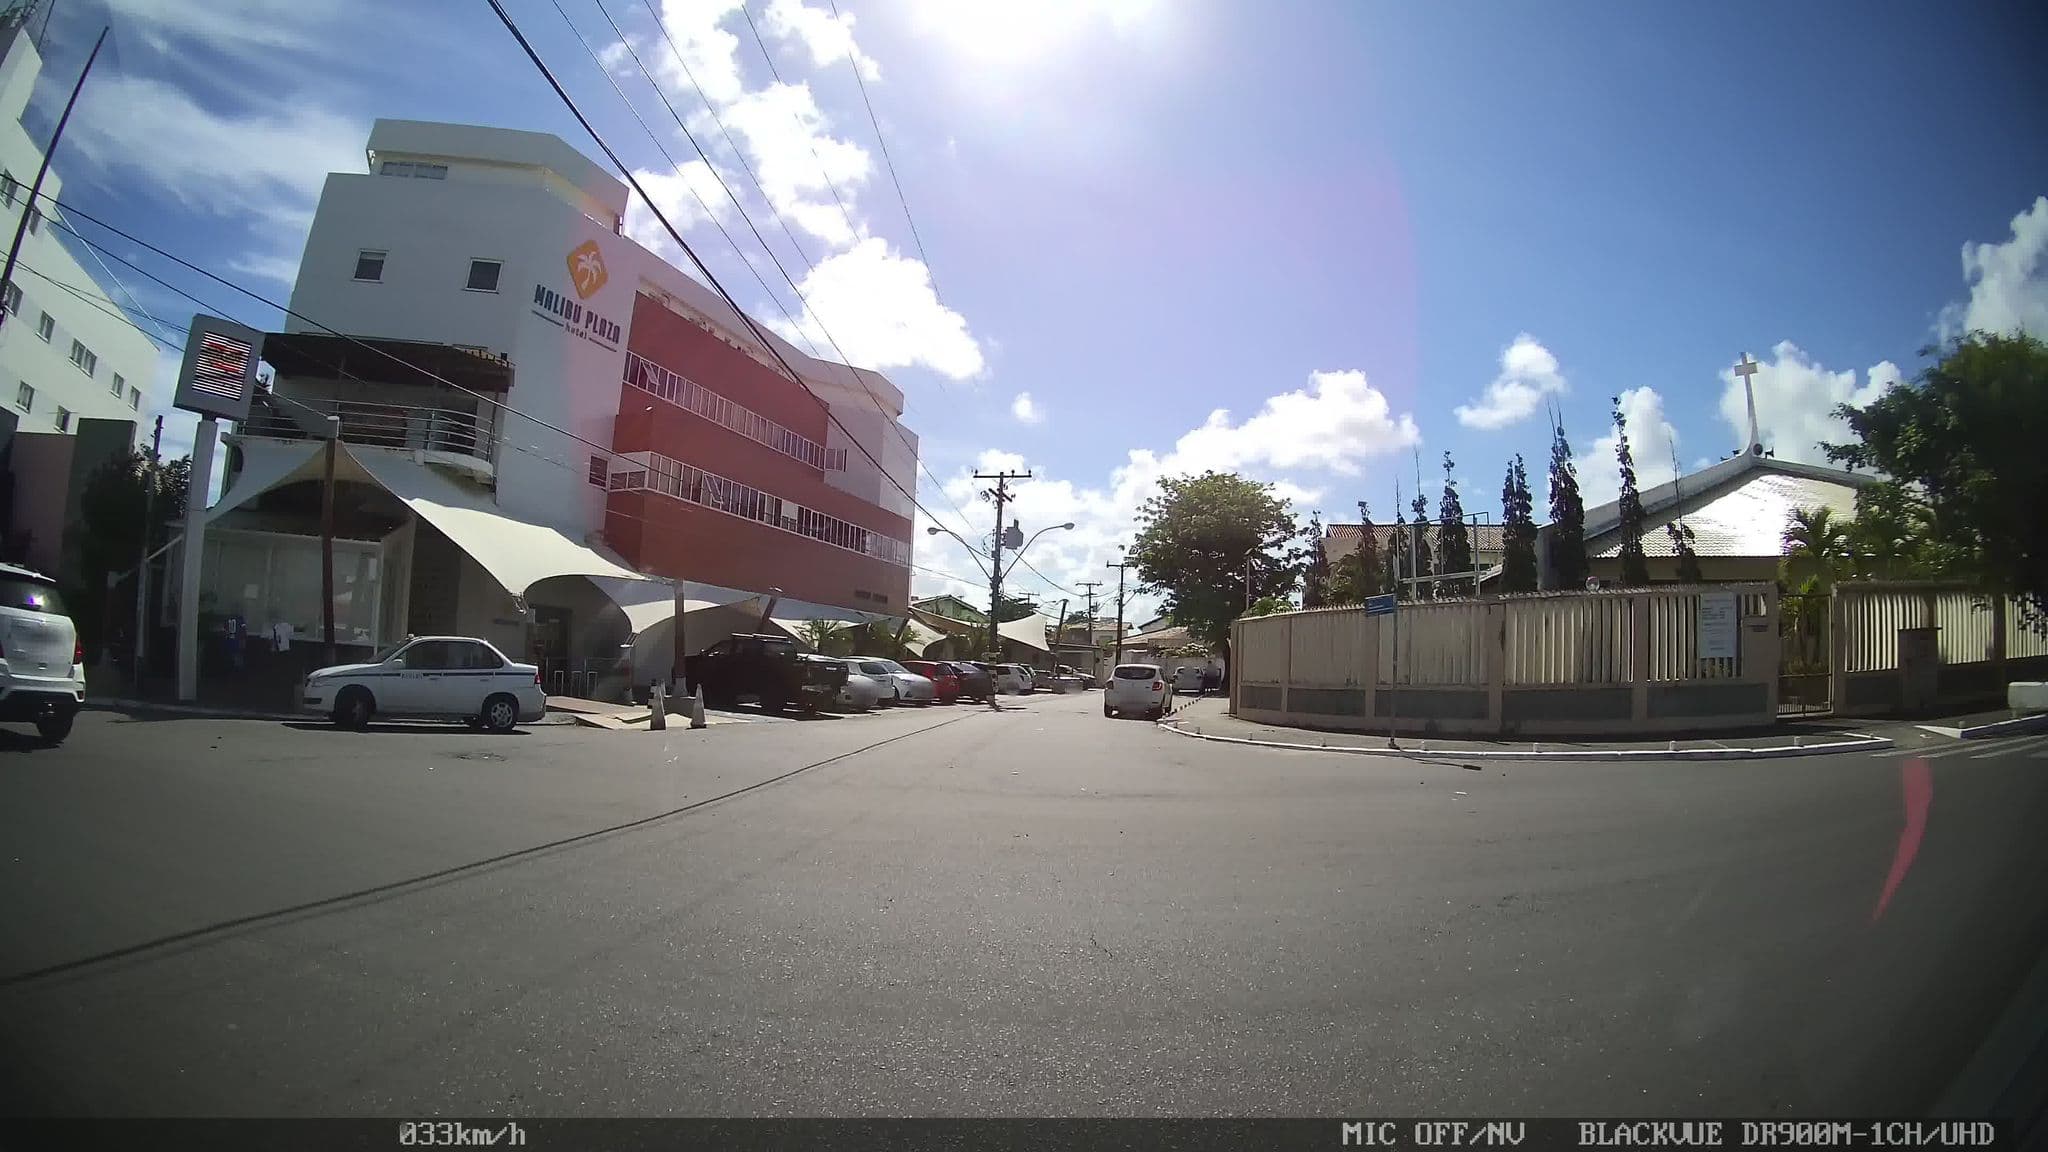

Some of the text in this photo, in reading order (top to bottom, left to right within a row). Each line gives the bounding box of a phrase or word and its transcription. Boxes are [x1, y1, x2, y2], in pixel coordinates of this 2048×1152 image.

[534, 284, 620, 344] MALIBU PLAZA
[565, 323, 587, 339] hotel
